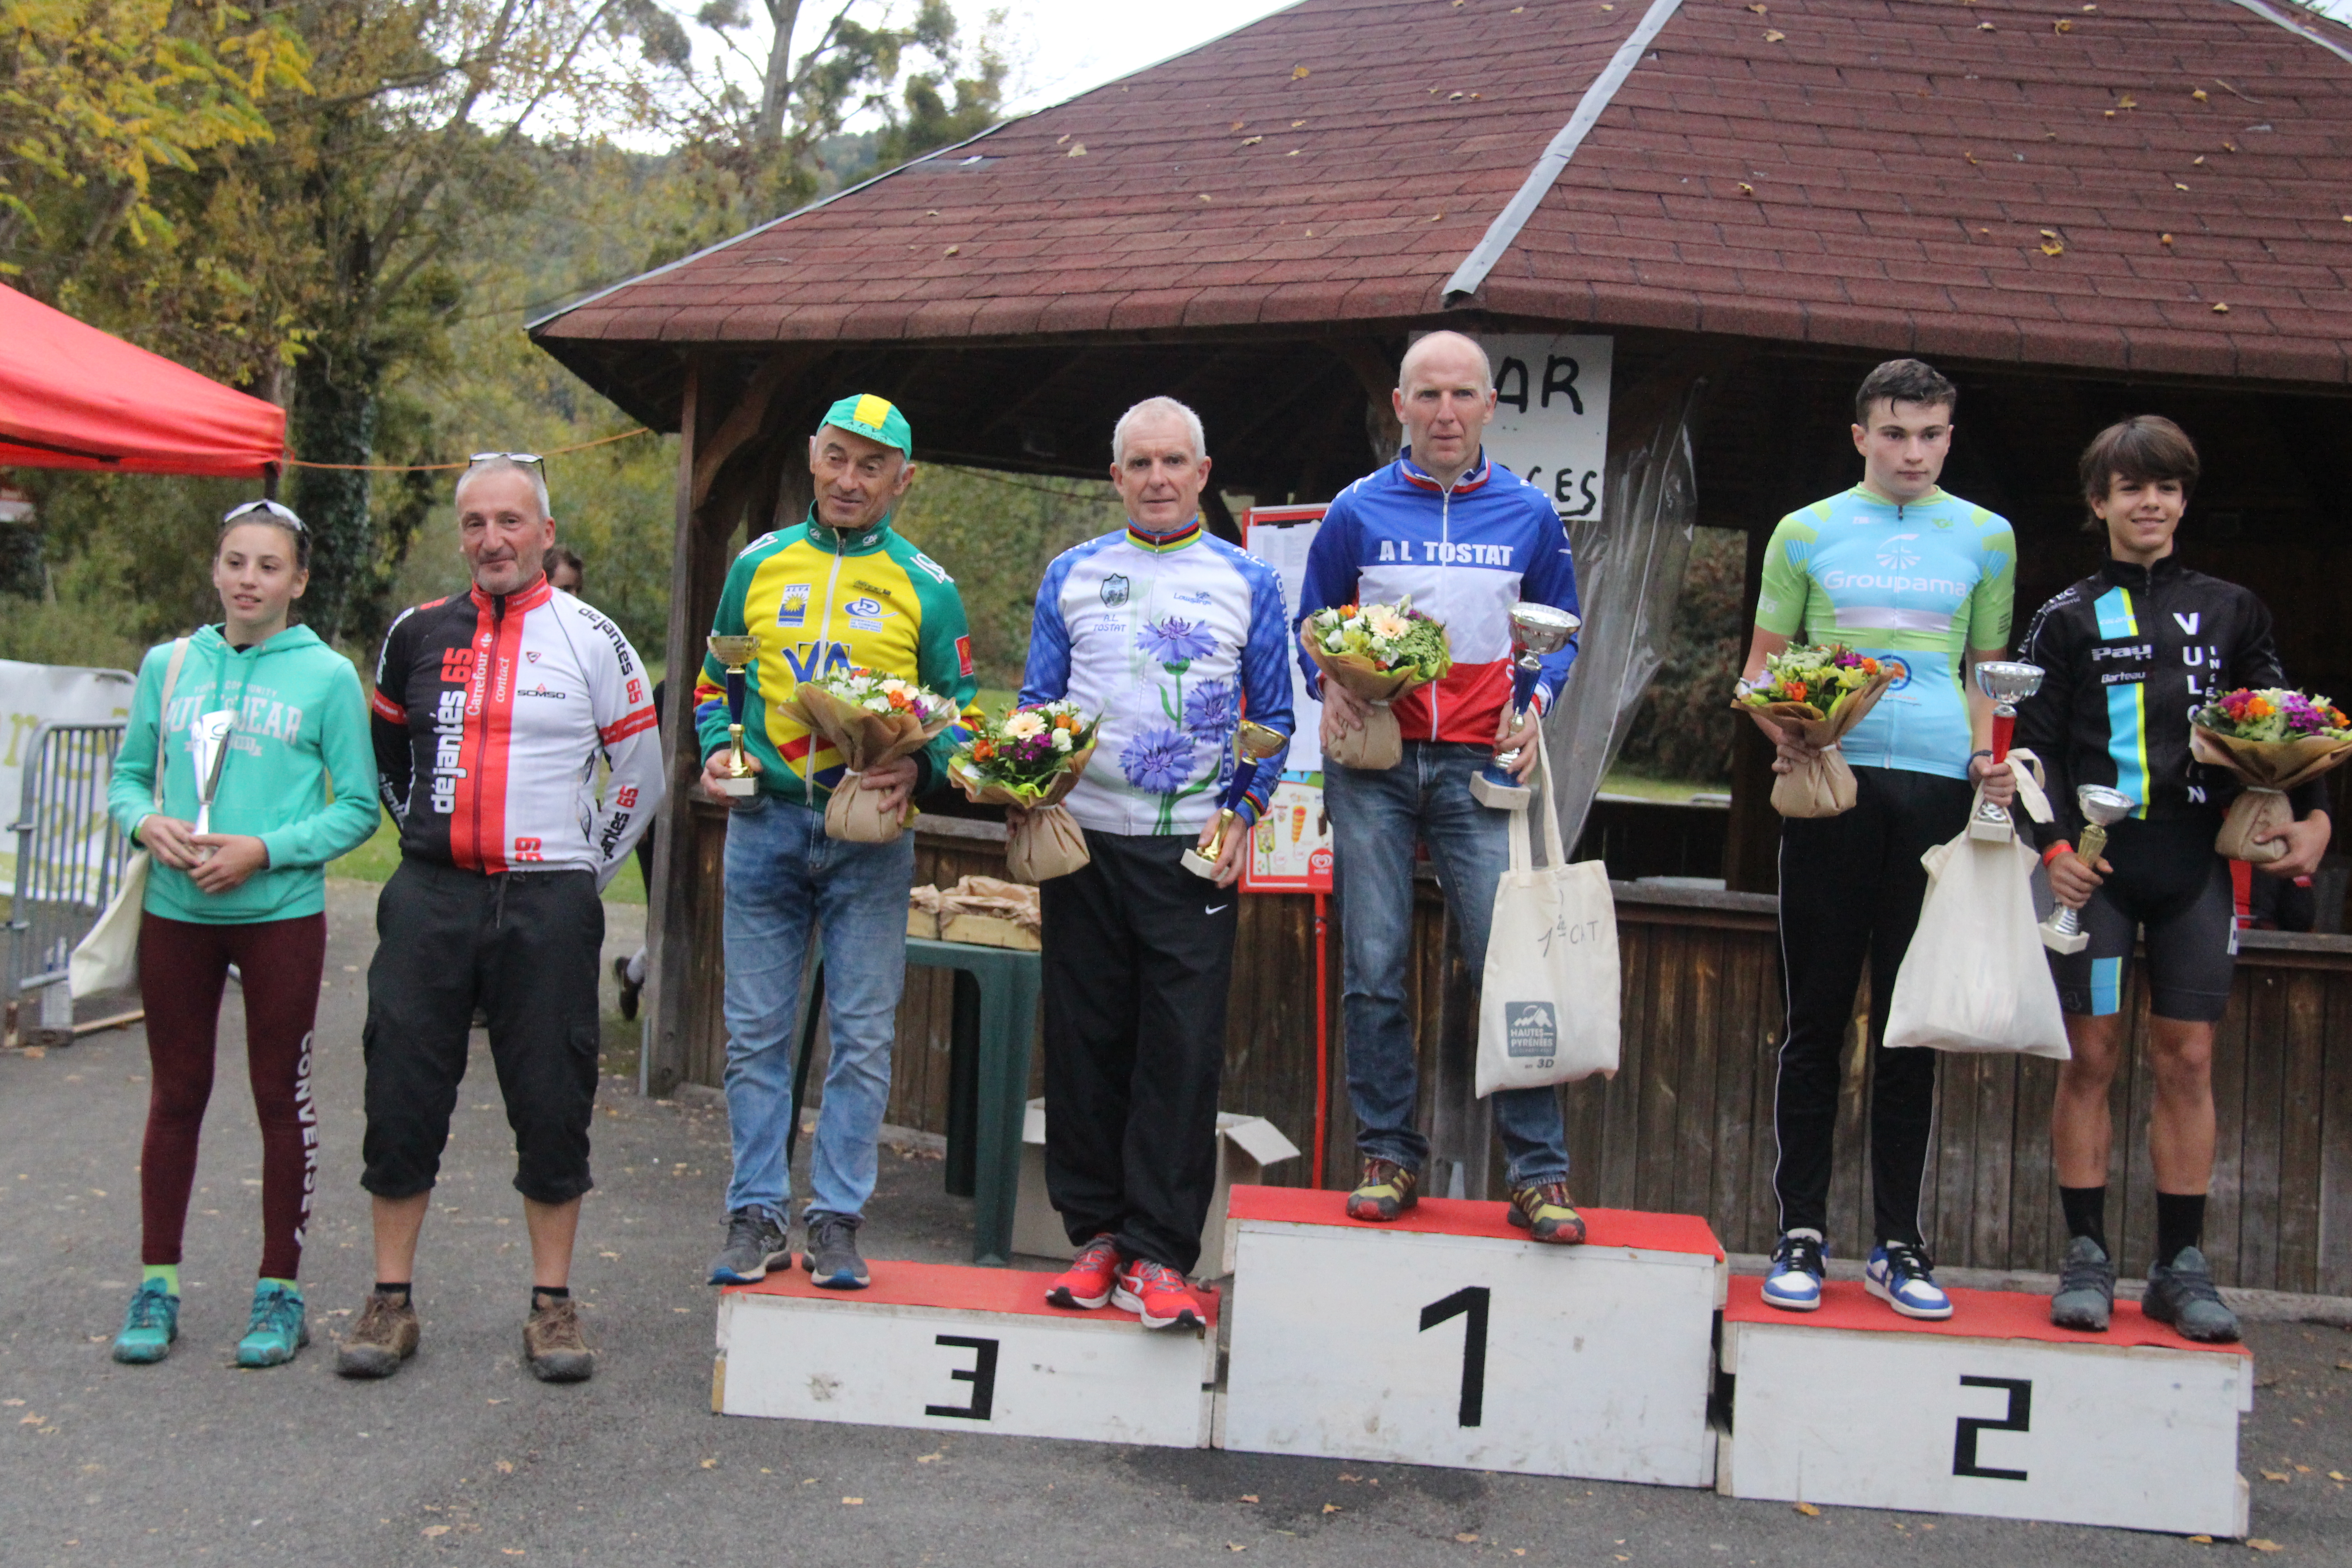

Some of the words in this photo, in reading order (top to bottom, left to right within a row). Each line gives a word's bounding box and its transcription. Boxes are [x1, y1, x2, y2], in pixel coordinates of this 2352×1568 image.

[1494, 356, 1584, 414] AR
[1423, 541, 1514, 567] TOSTAT
[1823, 570, 1967, 597] Groupama
[1093, 624, 1127, 632] TOSTAT
[1103, 614, 1118, 622] A.L.
[440, 647, 475, 683] 65
[495, 656, 510, 703] contact
[466, 651, 490, 716] Carrefour
[626, 678, 644, 705] 65
[616, 784, 639, 808] 65
[1537, 1058, 1554, 1068] 3D
[1419, 1285, 1491, 1429] 1
[924, 1333, 1000, 1421] 3
[1952, 1374, 2033, 1481] 2
